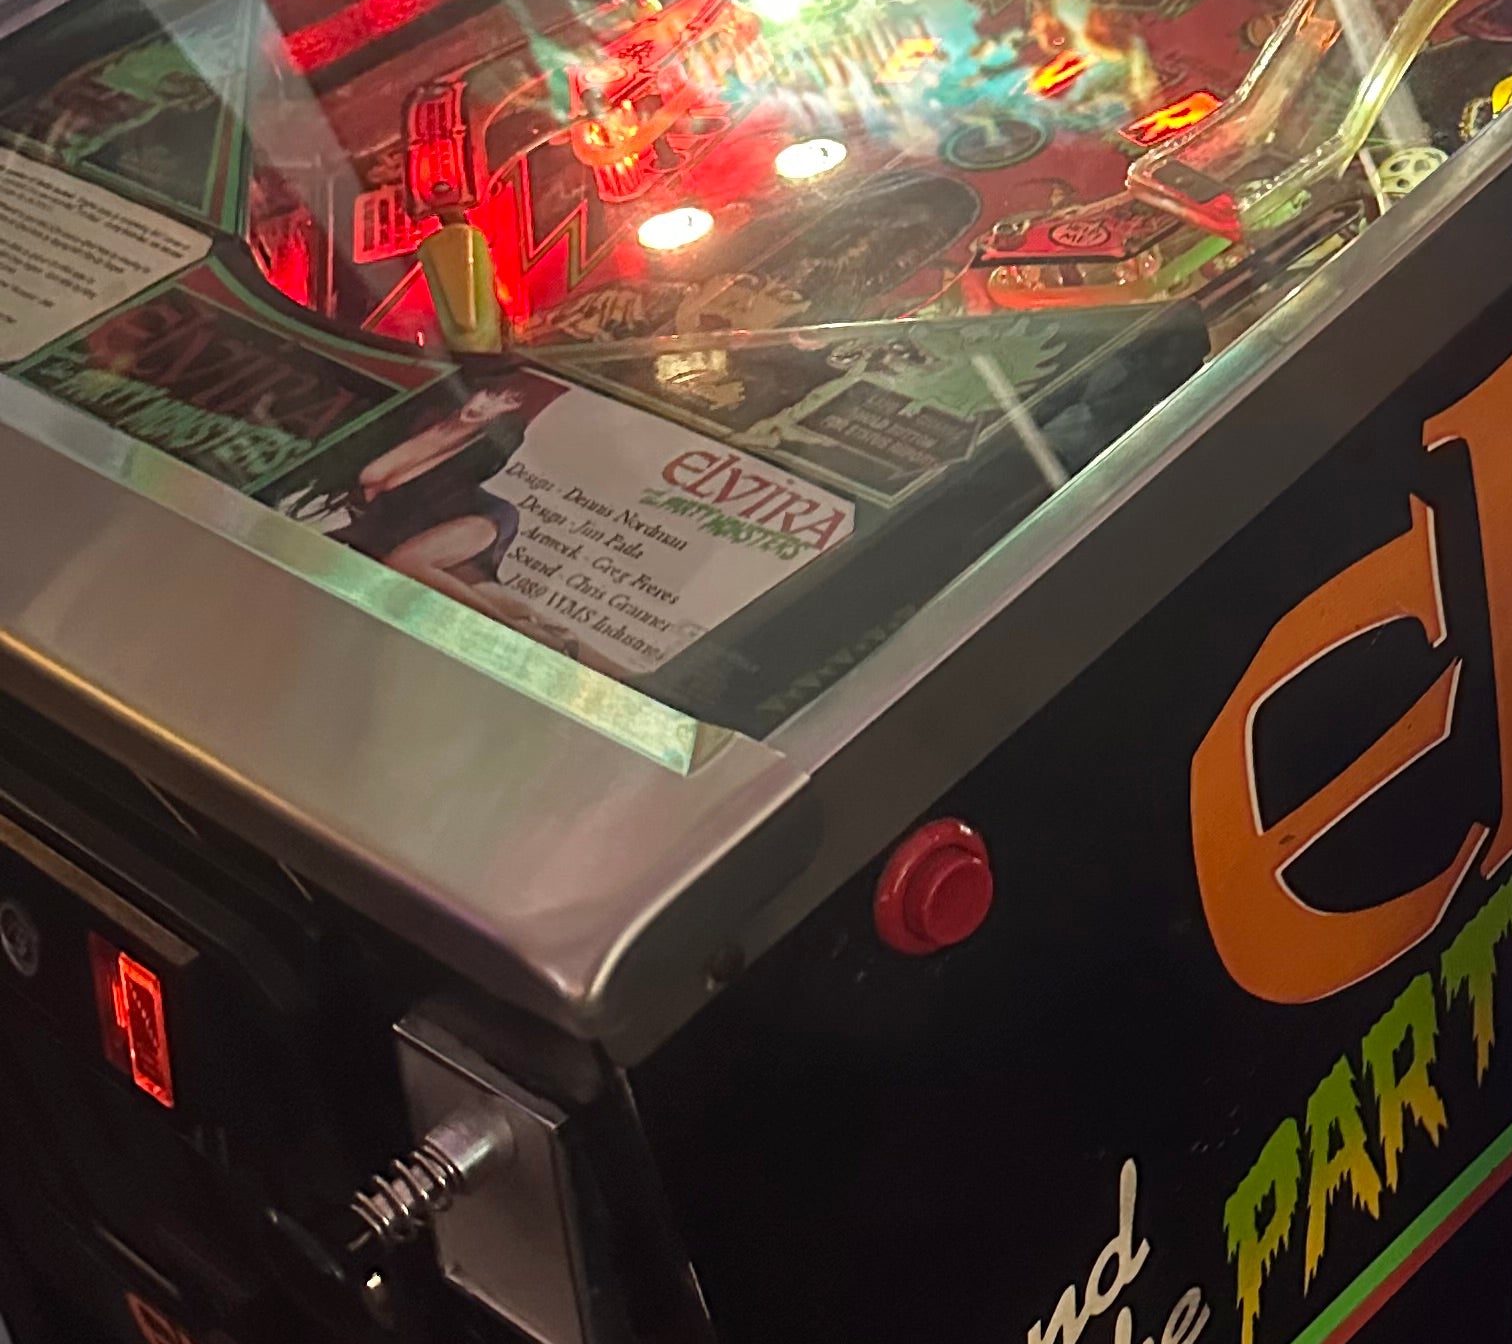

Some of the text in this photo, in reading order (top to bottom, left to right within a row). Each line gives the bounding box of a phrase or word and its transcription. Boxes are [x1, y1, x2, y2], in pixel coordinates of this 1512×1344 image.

[506, 461, 554, 493] Design
[563, 487, 611, 517] Dennis
[613, 509, 688, 552] Nordman
[518, 495, 567, 526] Design
[571, 520, 603, 542] Jim
[521, 525, 579, 559] Artwork
[592, 556, 633, 586] Greg
[508, 544, 673, 632] Sound Chris Granner
[548, 590, 592, 623] WMS
